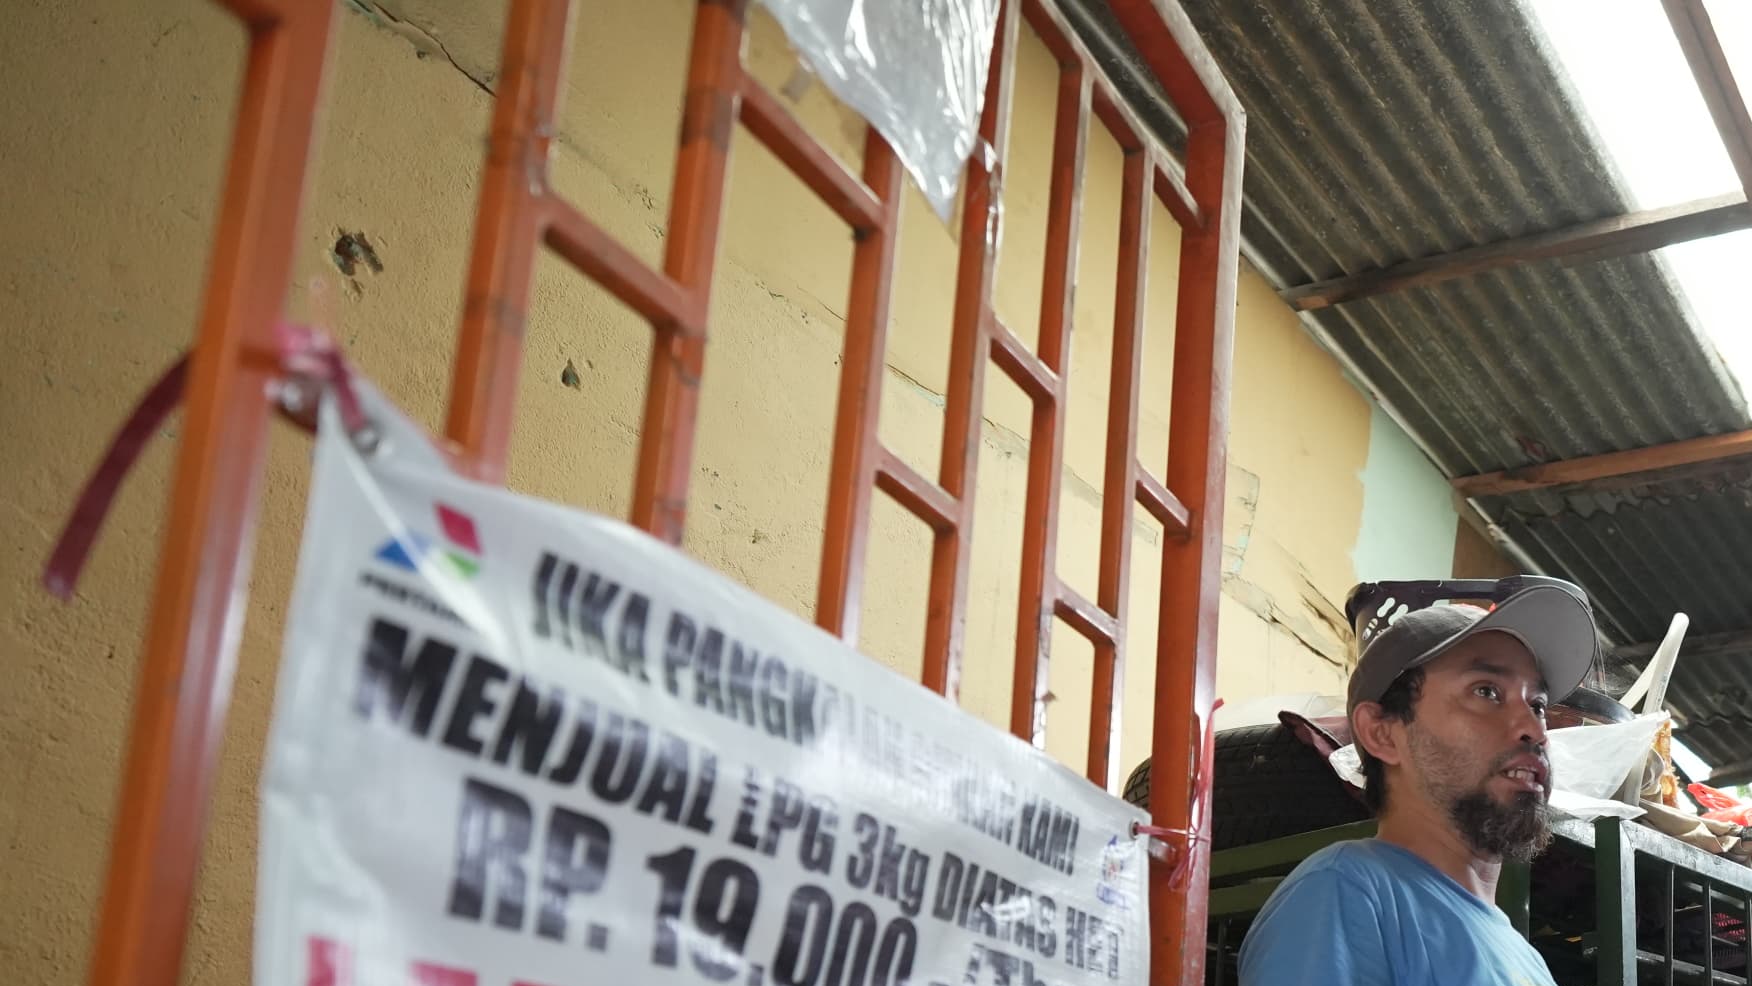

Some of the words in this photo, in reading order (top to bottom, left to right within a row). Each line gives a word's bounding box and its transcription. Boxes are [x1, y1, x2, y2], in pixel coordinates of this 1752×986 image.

[355, 616, 718, 835] MENJUAL
[730, 766, 839, 874] LPG
[845, 812, 930, 918] 3kg
[933, 852, 1057, 958] DIATAS
[449, 777, 607, 951] RP.
[532, 551, 653, 683] JIKA
[1017, 800, 1080, 877] KAMI
